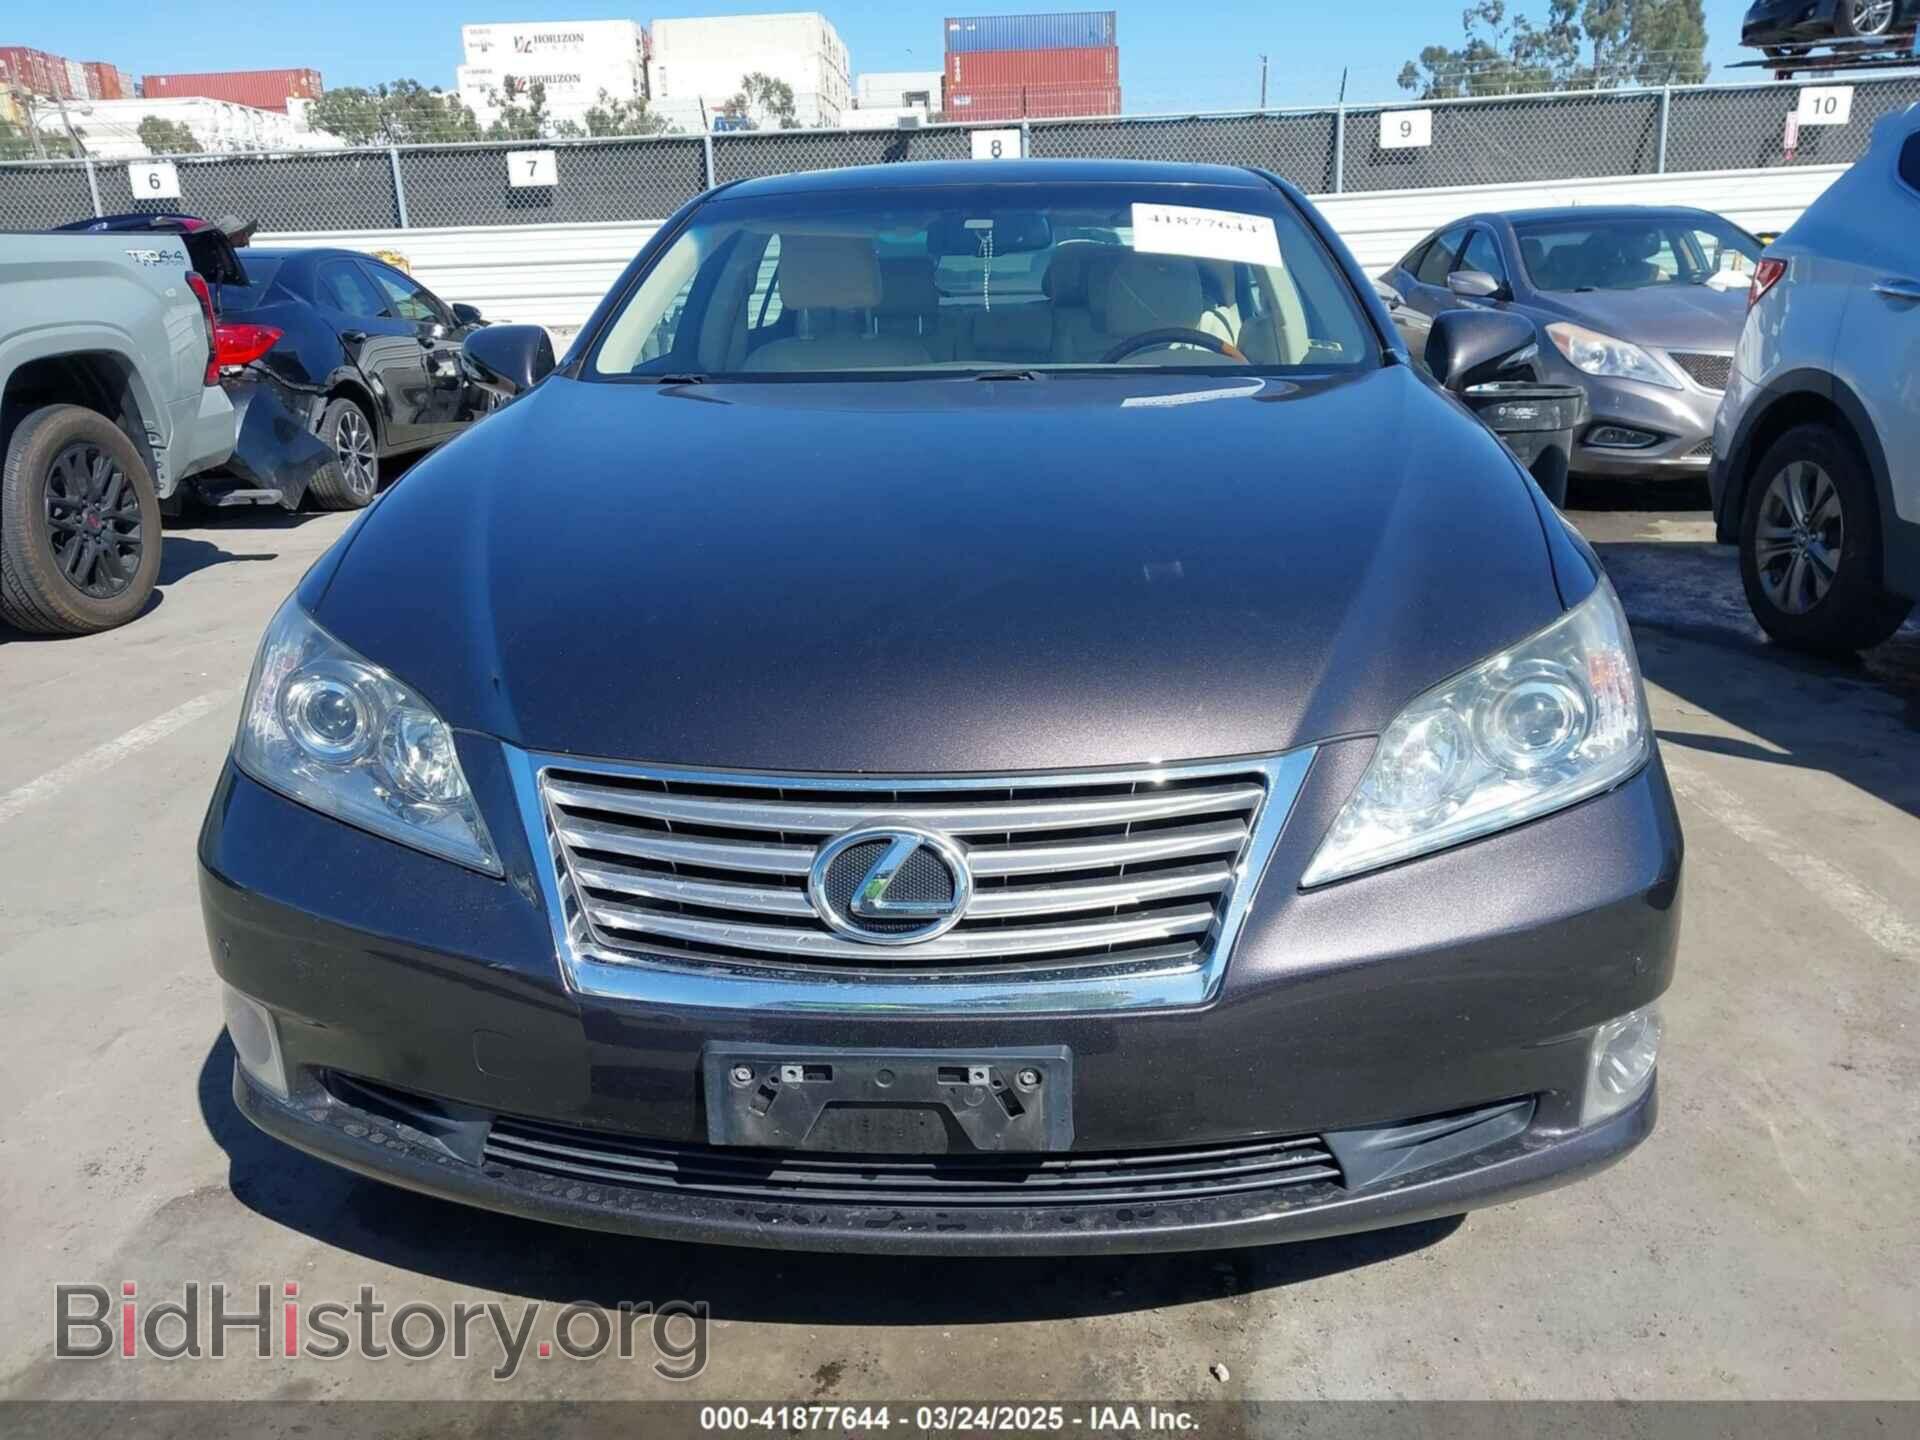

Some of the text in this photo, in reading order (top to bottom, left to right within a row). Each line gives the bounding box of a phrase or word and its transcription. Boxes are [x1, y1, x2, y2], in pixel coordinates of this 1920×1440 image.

[533, 32, 585, 44] HORIZON
[529, 73, 581, 85] HORIZON
[1814, 96, 1838, 115] 10
[1400, 120, 1412, 138] 9
[991, 139, 1002, 158] 8
[526, 160, 537, 177] 7
[148, 172, 161, 190] 6
